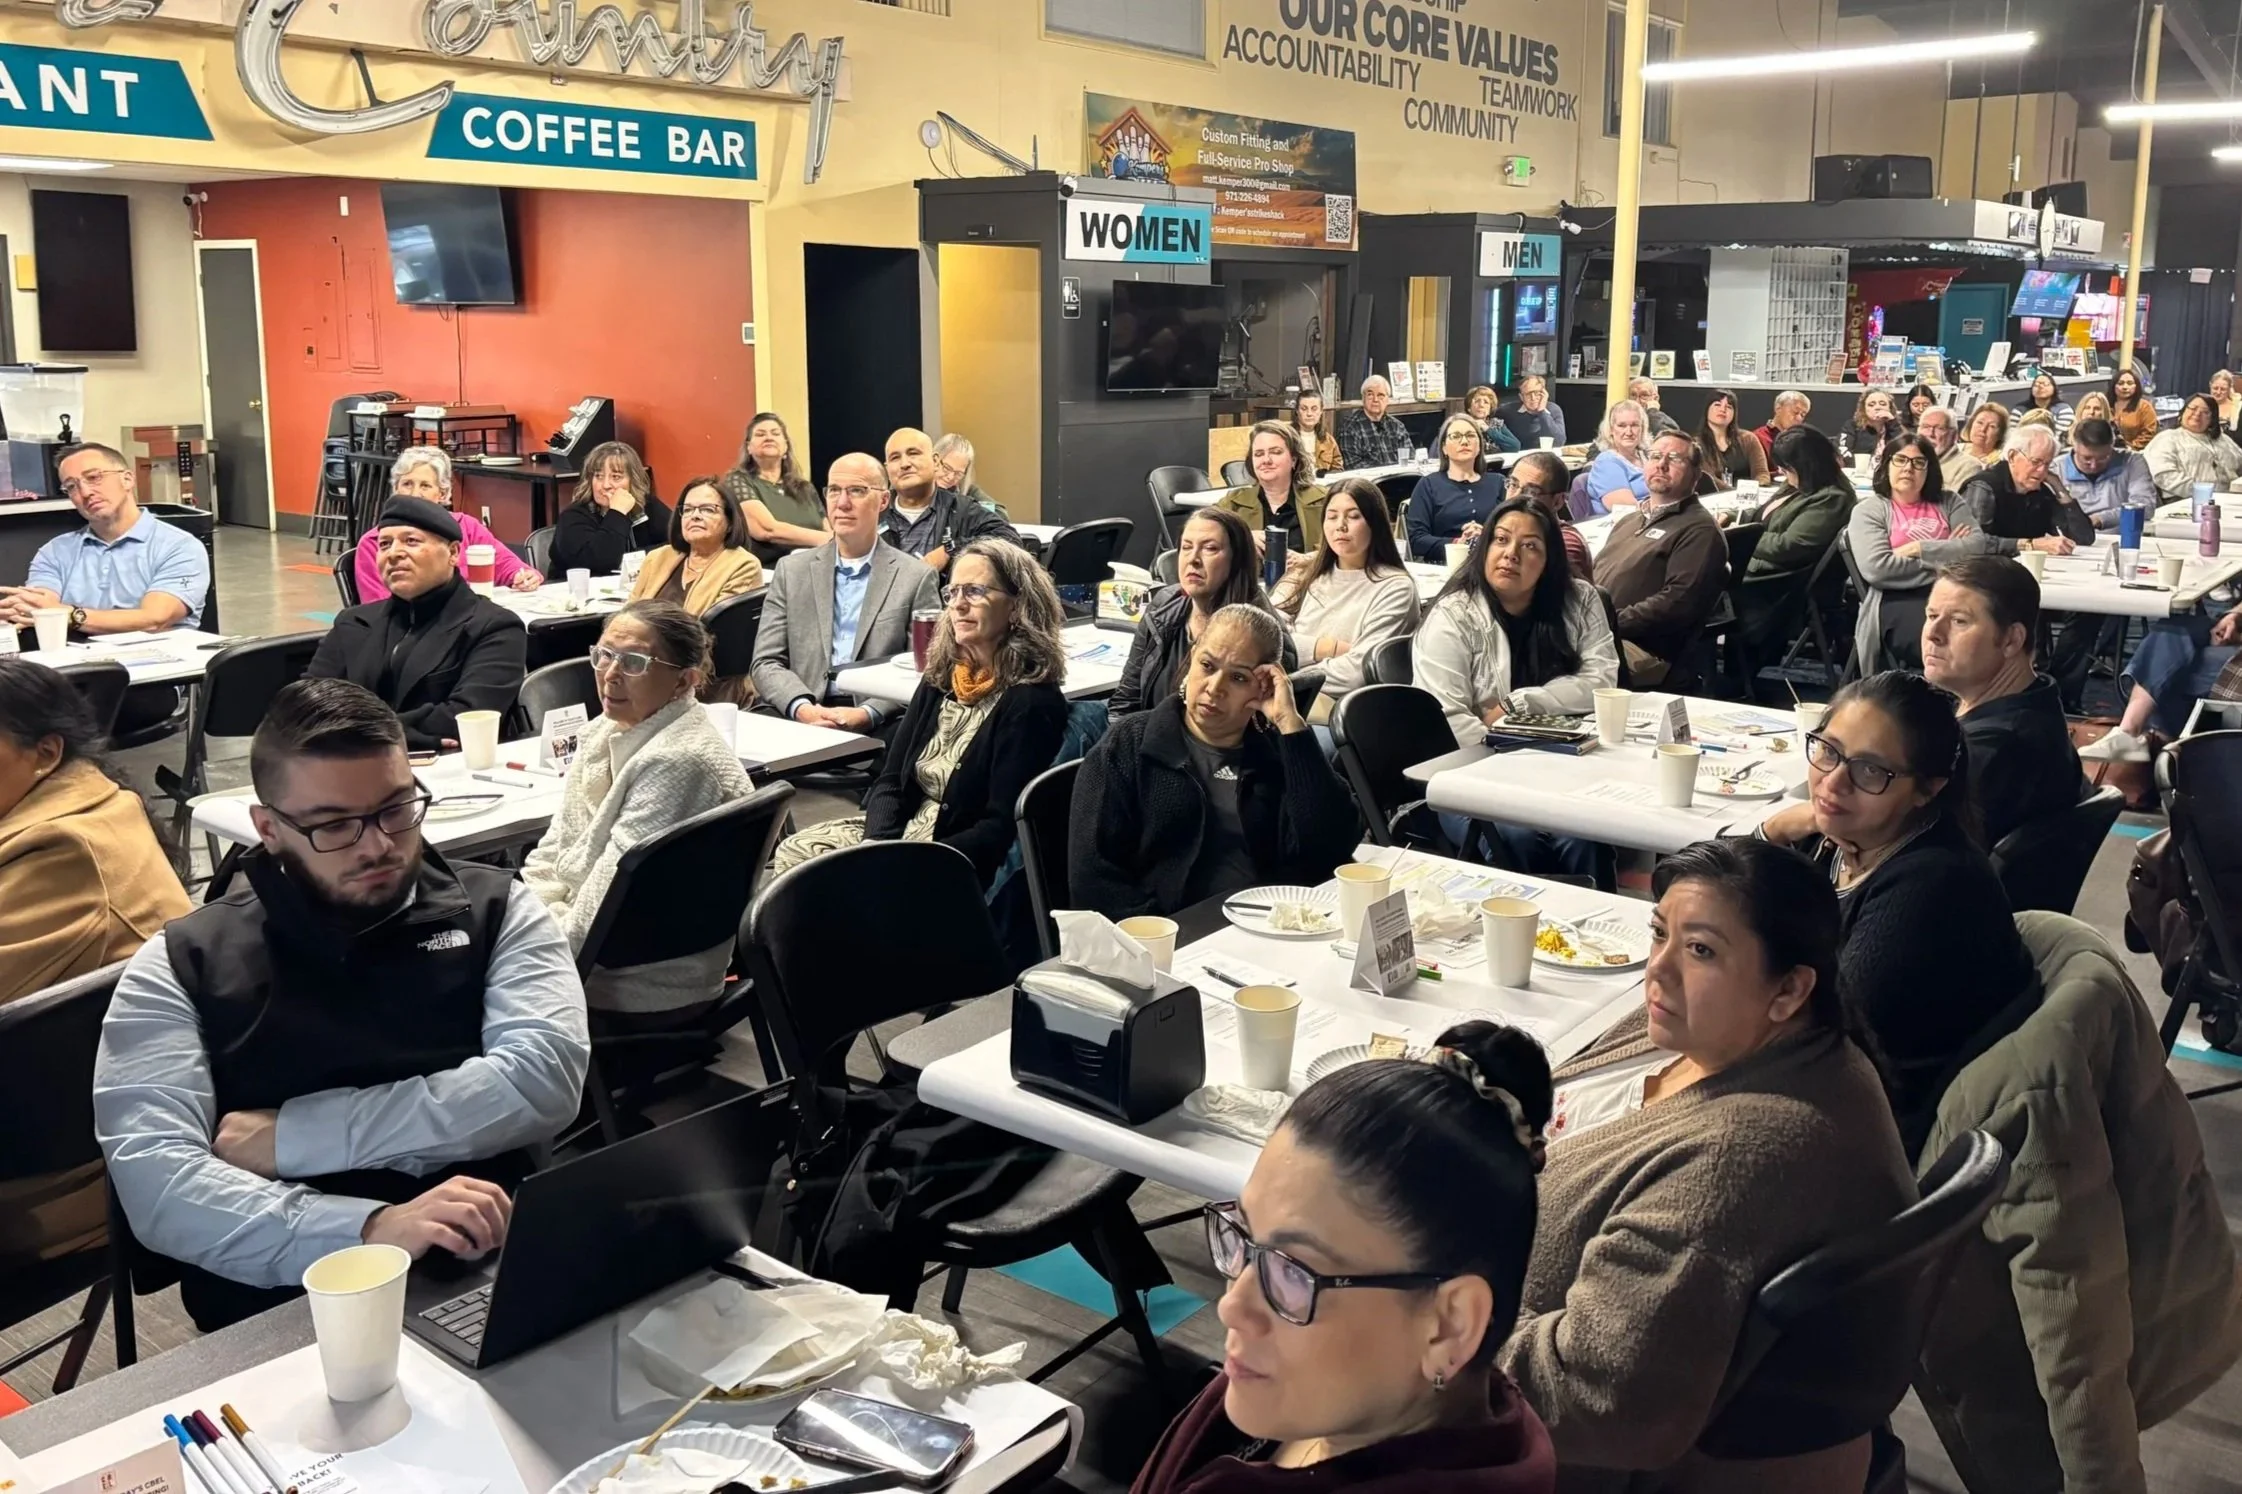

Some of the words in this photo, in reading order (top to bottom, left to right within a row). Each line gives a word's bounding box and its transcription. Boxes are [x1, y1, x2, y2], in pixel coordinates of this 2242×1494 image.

[1223, 24, 1422, 92] ACCOUNTABILITY
[1280, 0, 1357, 42] OUR
[1363, 0, 1450, 62] CORE
[1455, 21, 1559, 87] VALUES
[1404, 97, 1519, 144] COMMUNITY
[1479, 75, 1578, 122] TEAMWORK
[461, 107, 641, 160] COFFEE
[667, 126, 746, 168] BAR
[1202, 127, 1238, 145] Custom
[1240, 132, 1271, 152] Fitting
[1273, 138, 1289, 152] and
[1197, 150, 1252, 169] Full-Service
[1254, 156, 1270, 172] Pro
[1272, 160, 1294, 176] Shop
[1080, 211, 1201, 253] WOMEN
[1503, 241, 1543, 268] MEN
[308, 1452, 344, 1471] YOUR
